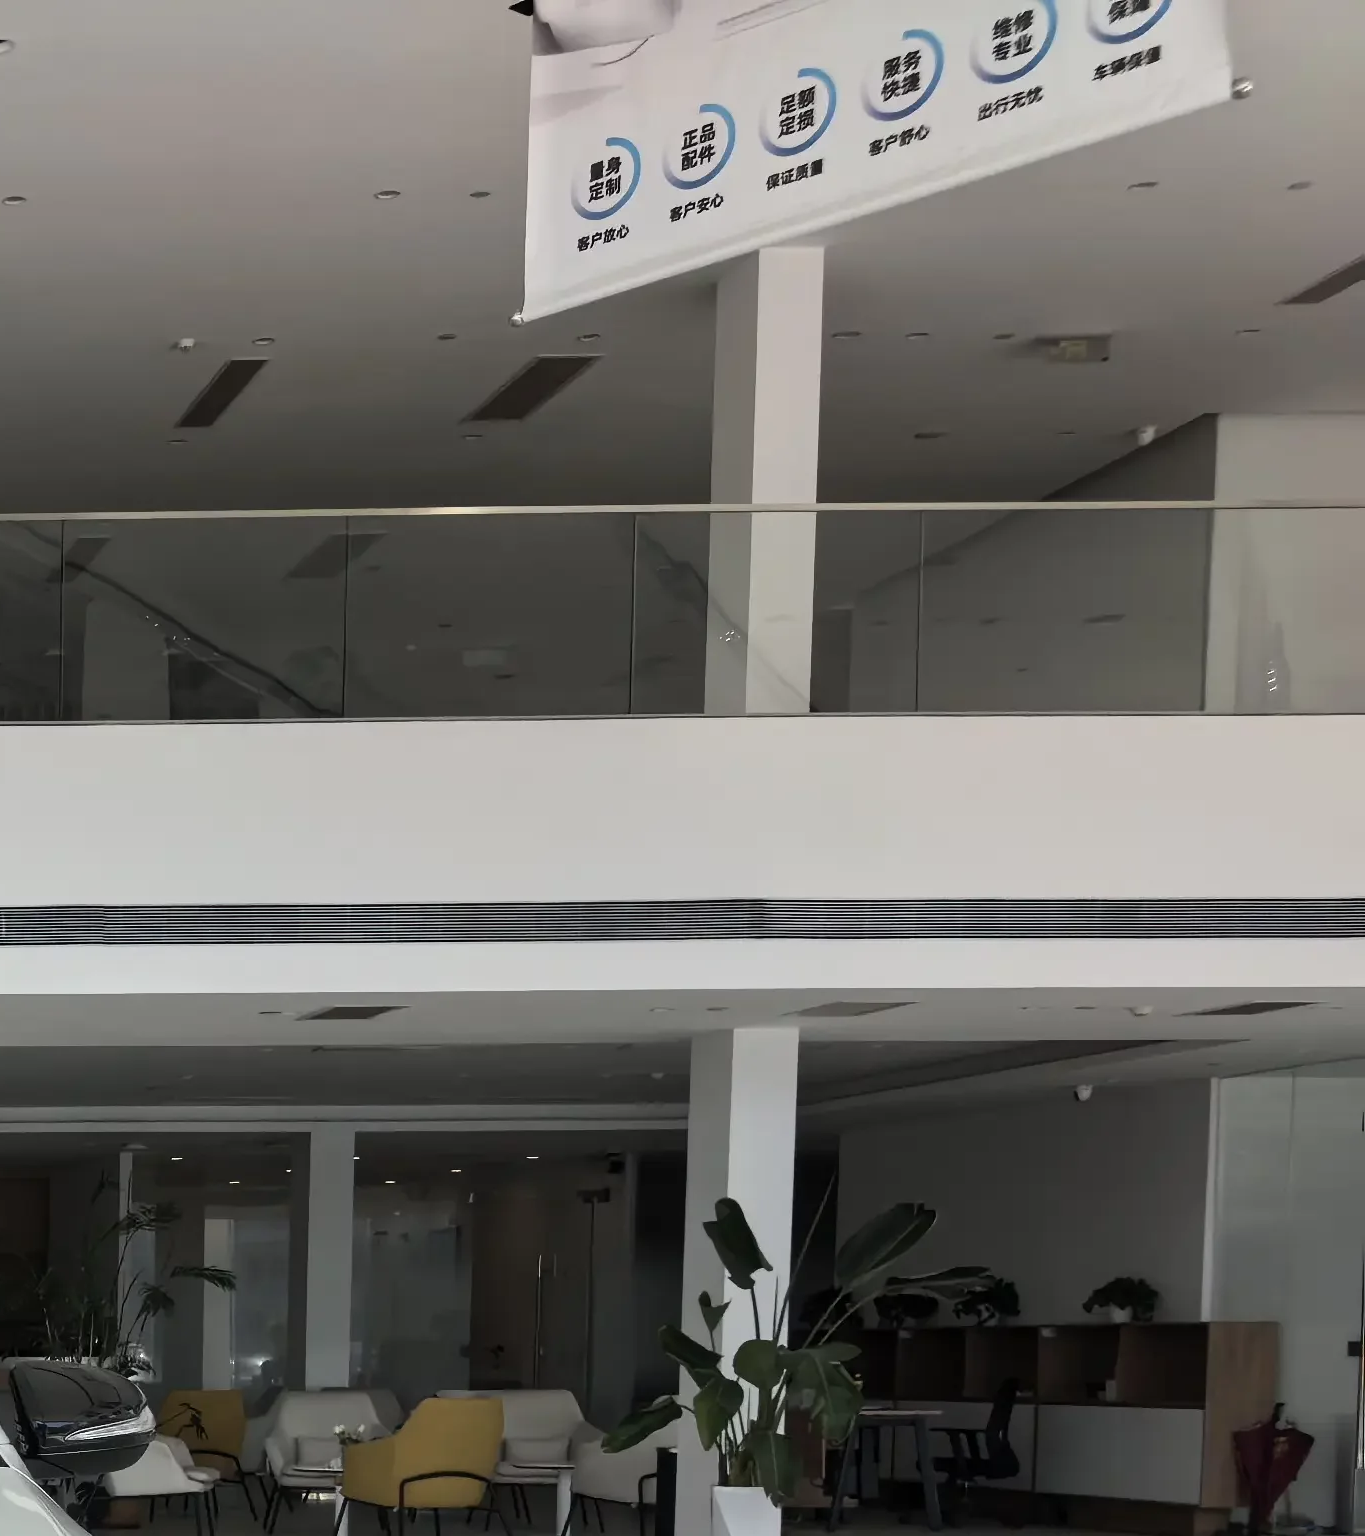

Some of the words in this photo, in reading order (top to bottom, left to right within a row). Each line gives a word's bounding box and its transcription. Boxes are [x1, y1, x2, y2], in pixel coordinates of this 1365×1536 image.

[992, 9, 1034, 41] 维修
[992, 34, 1033, 61] 专业
[882, 49, 922, 80] 服务
[779, 85, 816, 117] 足额
[881, 72, 921, 102] 快捷
[977, 86, 1044, 121] 出行无忧
[681, 122, 716, 150] 正品
[777, 108, 815, 138] 定损
[868, 124, 930, 156] 客户舒心
[589, 156, 622, 184] 量身
[681, 144, 716, 171] 配件
[588, 175, 622, 203] 定制
[765, 158, 824, 191] 保证质量
[669, 193, 724, 222] 客户安心
[576, 224, 630, 251] 客户放心
